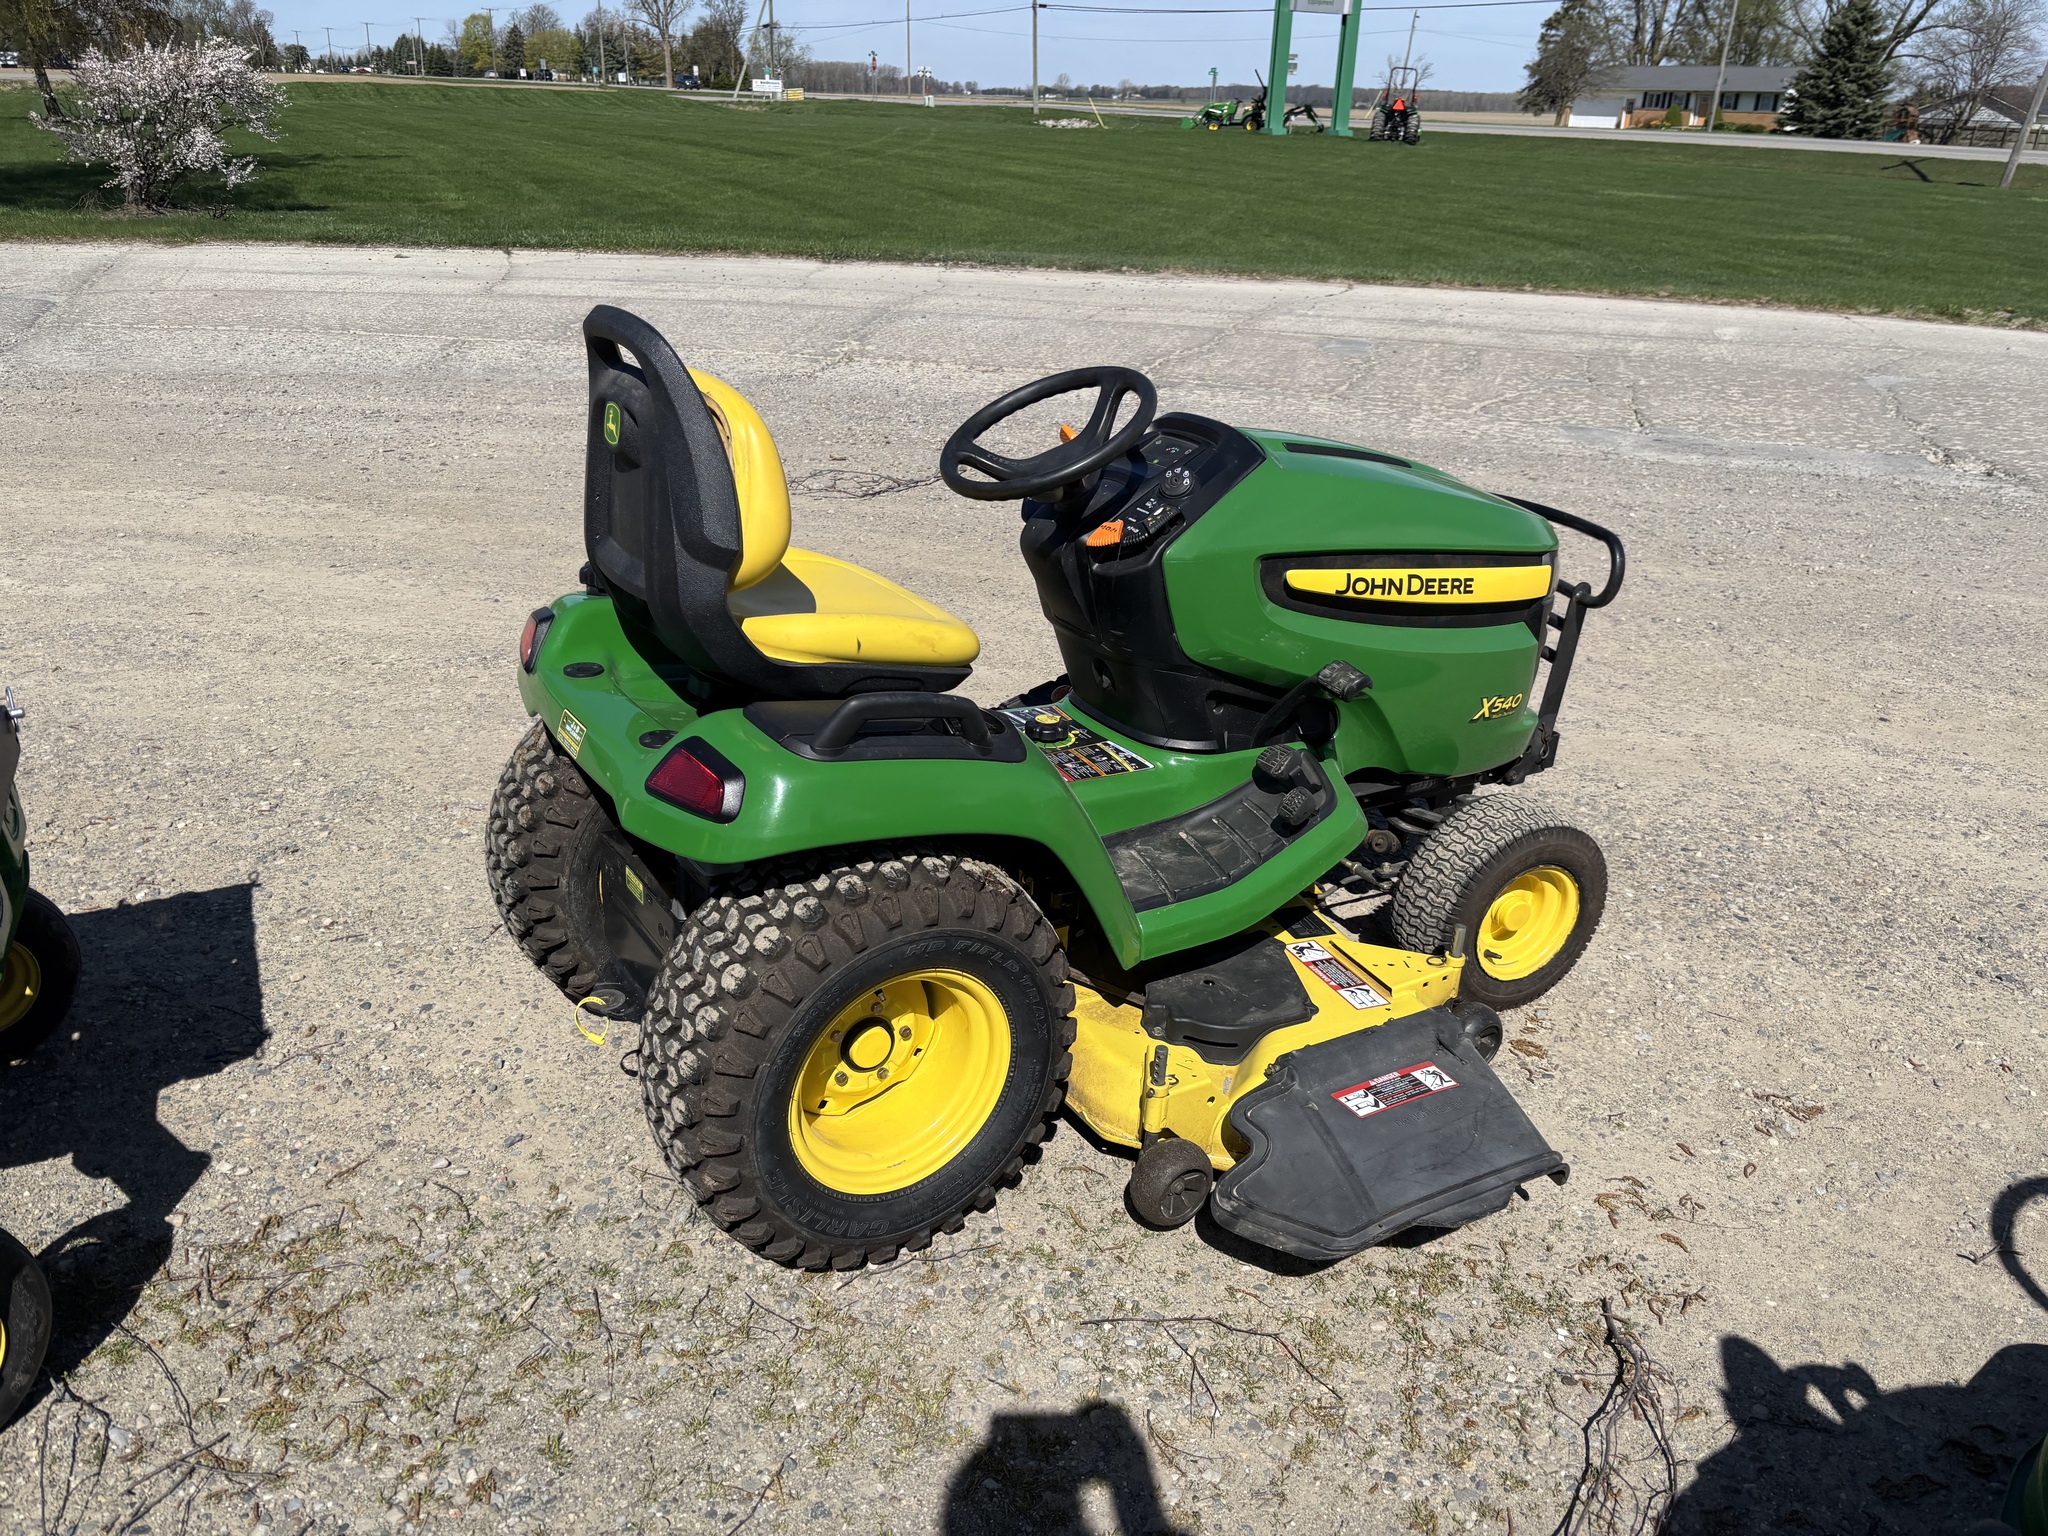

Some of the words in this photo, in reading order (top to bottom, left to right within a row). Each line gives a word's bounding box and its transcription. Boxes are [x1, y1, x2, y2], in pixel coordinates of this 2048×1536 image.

[1335, 573, 1403, 596] JOHN
[1406, 574, 1475, 596] DEERE
[1470, 692, 1523, 722] X540
[904, 940, 946, 958] HD
[952, 940, 1021, 973] FIELD
[1019, 974, 1048, 1041] TRAX
[1373, 1071, 1401, 1083] DANGER
